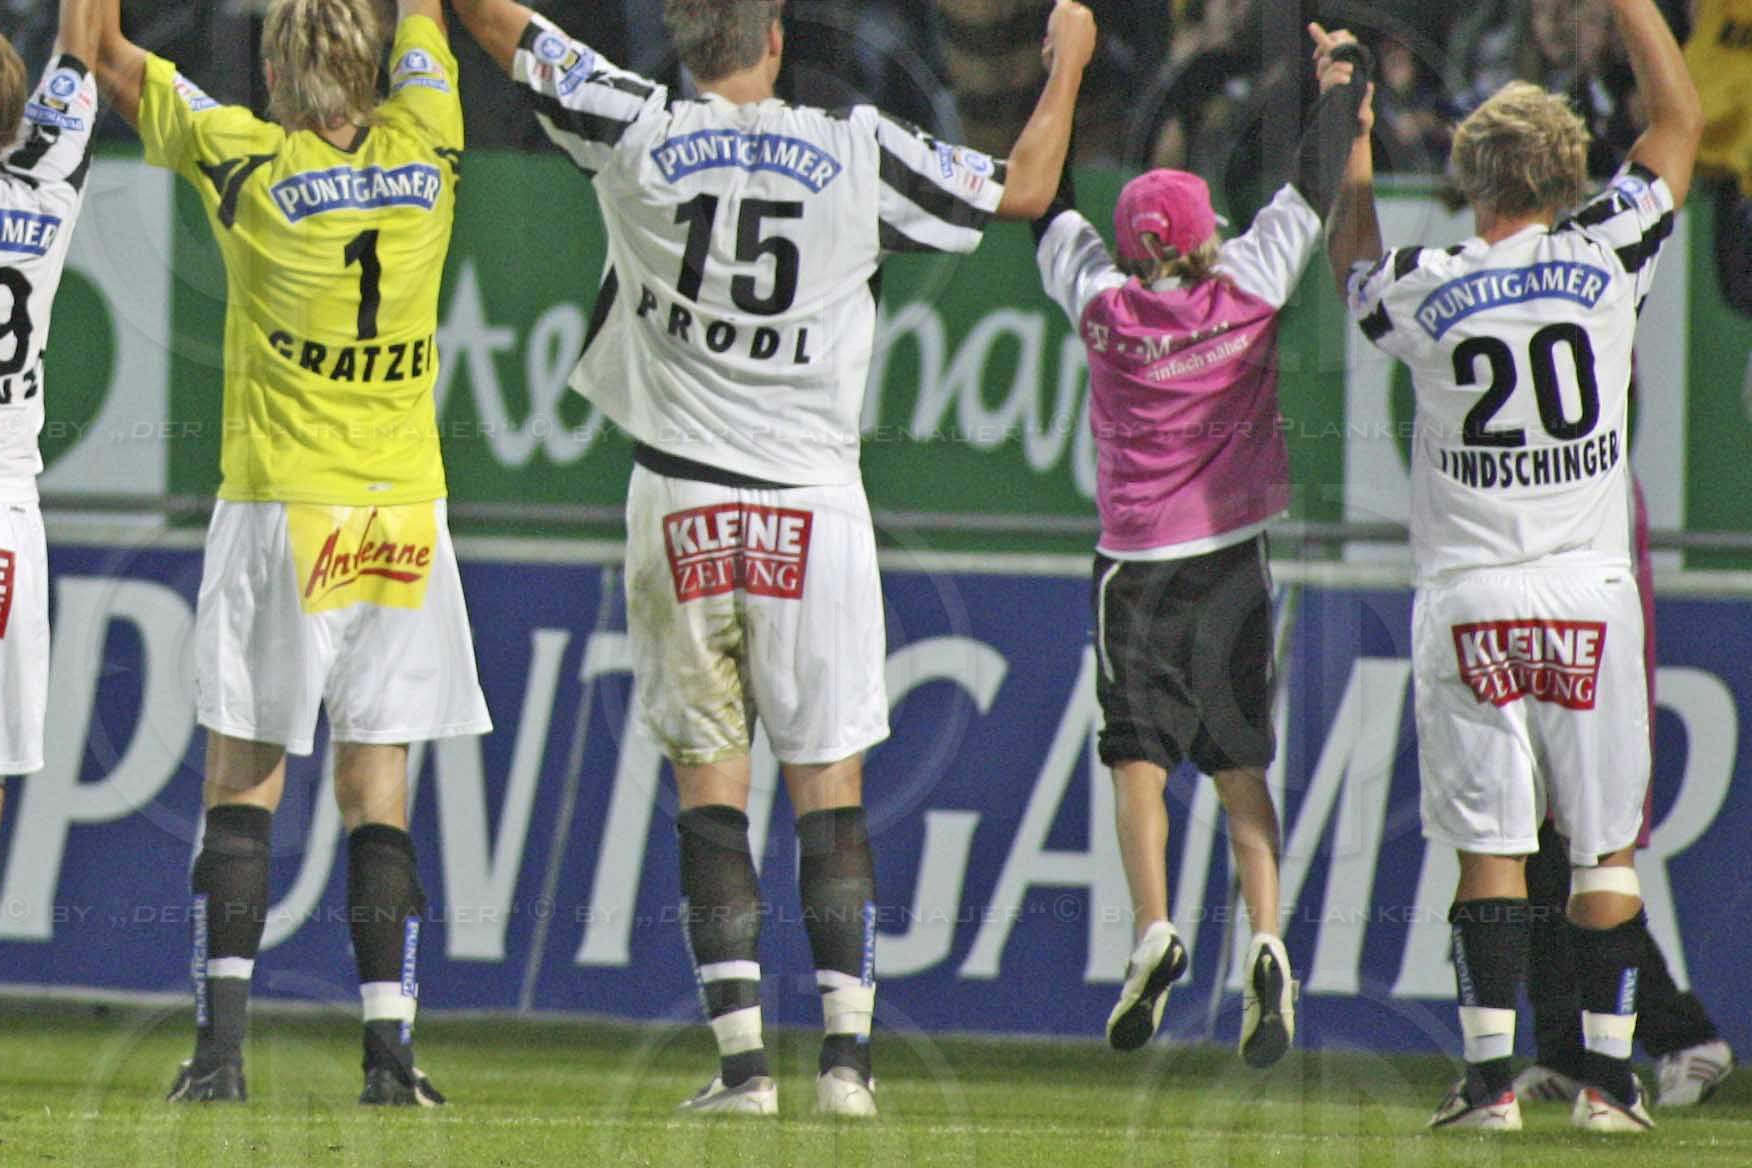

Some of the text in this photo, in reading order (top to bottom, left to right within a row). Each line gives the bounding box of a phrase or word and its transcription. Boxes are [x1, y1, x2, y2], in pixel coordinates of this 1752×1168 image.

[279, 171, 440, 213] PUNTGAMER
[344, 228, 382, 341] 1
[673, 192, 804, 317] 15
[1419, 266, 1604, 332] PUNTIGAMER
[1451, 322, 1601, 448] 20
[304, 507, 431, 598] Antenne
[679, 556, 799, 595] ZEING
[1460, 626, 1599, 669] KLEINE
